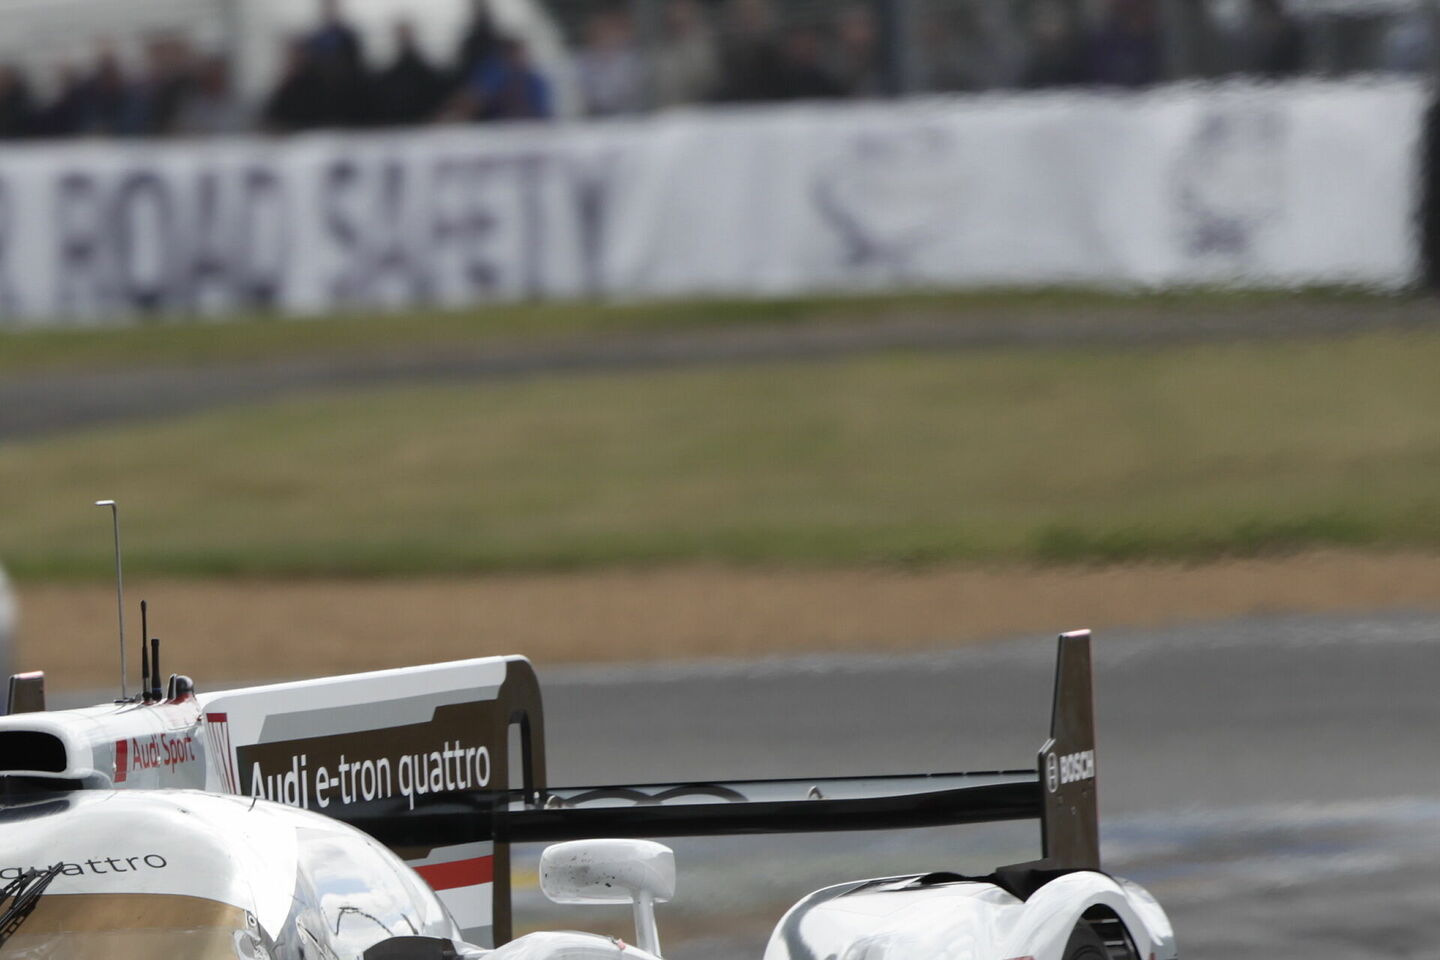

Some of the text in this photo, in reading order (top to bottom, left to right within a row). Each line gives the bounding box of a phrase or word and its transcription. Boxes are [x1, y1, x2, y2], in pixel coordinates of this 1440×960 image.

[57, 168, 289, 312] ROAD
[322, 150, 624, 305] SAFETY
[132, 732, 195, 774] Audi Sport
[250, 740, 491, 810] Audi e-tron quattro
[1060, 750, 1096, 785] BOSCH
